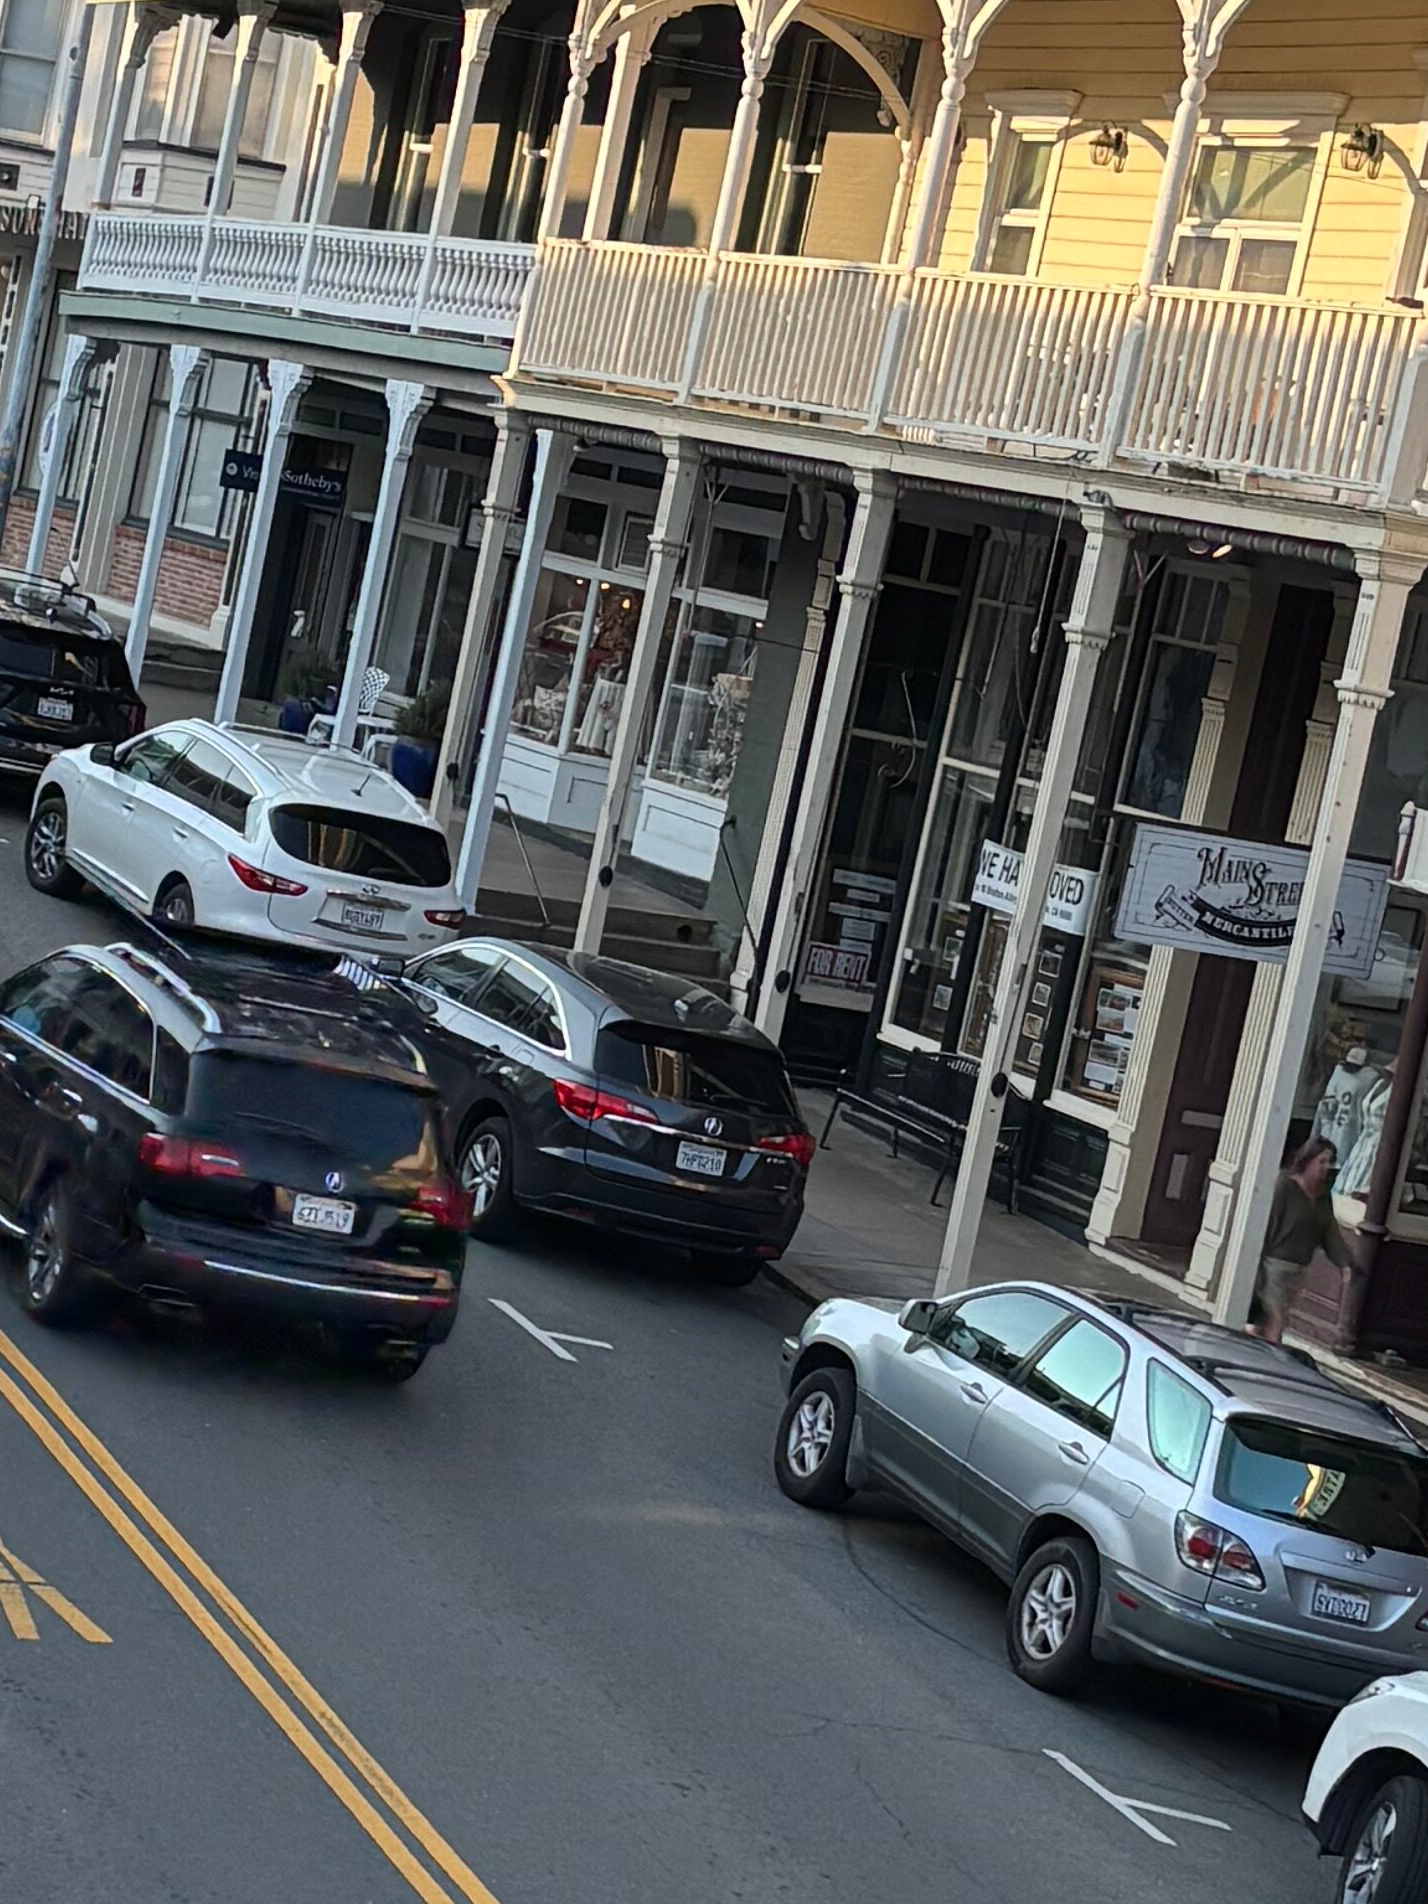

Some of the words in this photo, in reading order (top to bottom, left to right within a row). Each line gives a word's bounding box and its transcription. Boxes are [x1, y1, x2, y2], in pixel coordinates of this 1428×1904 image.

[1196, 846, 1254, 889] MAIN
[1048, 871, 1085, 906] OVED
[808, 947, 833, 976] FOR
[832, 951, 867, 982] RENT
